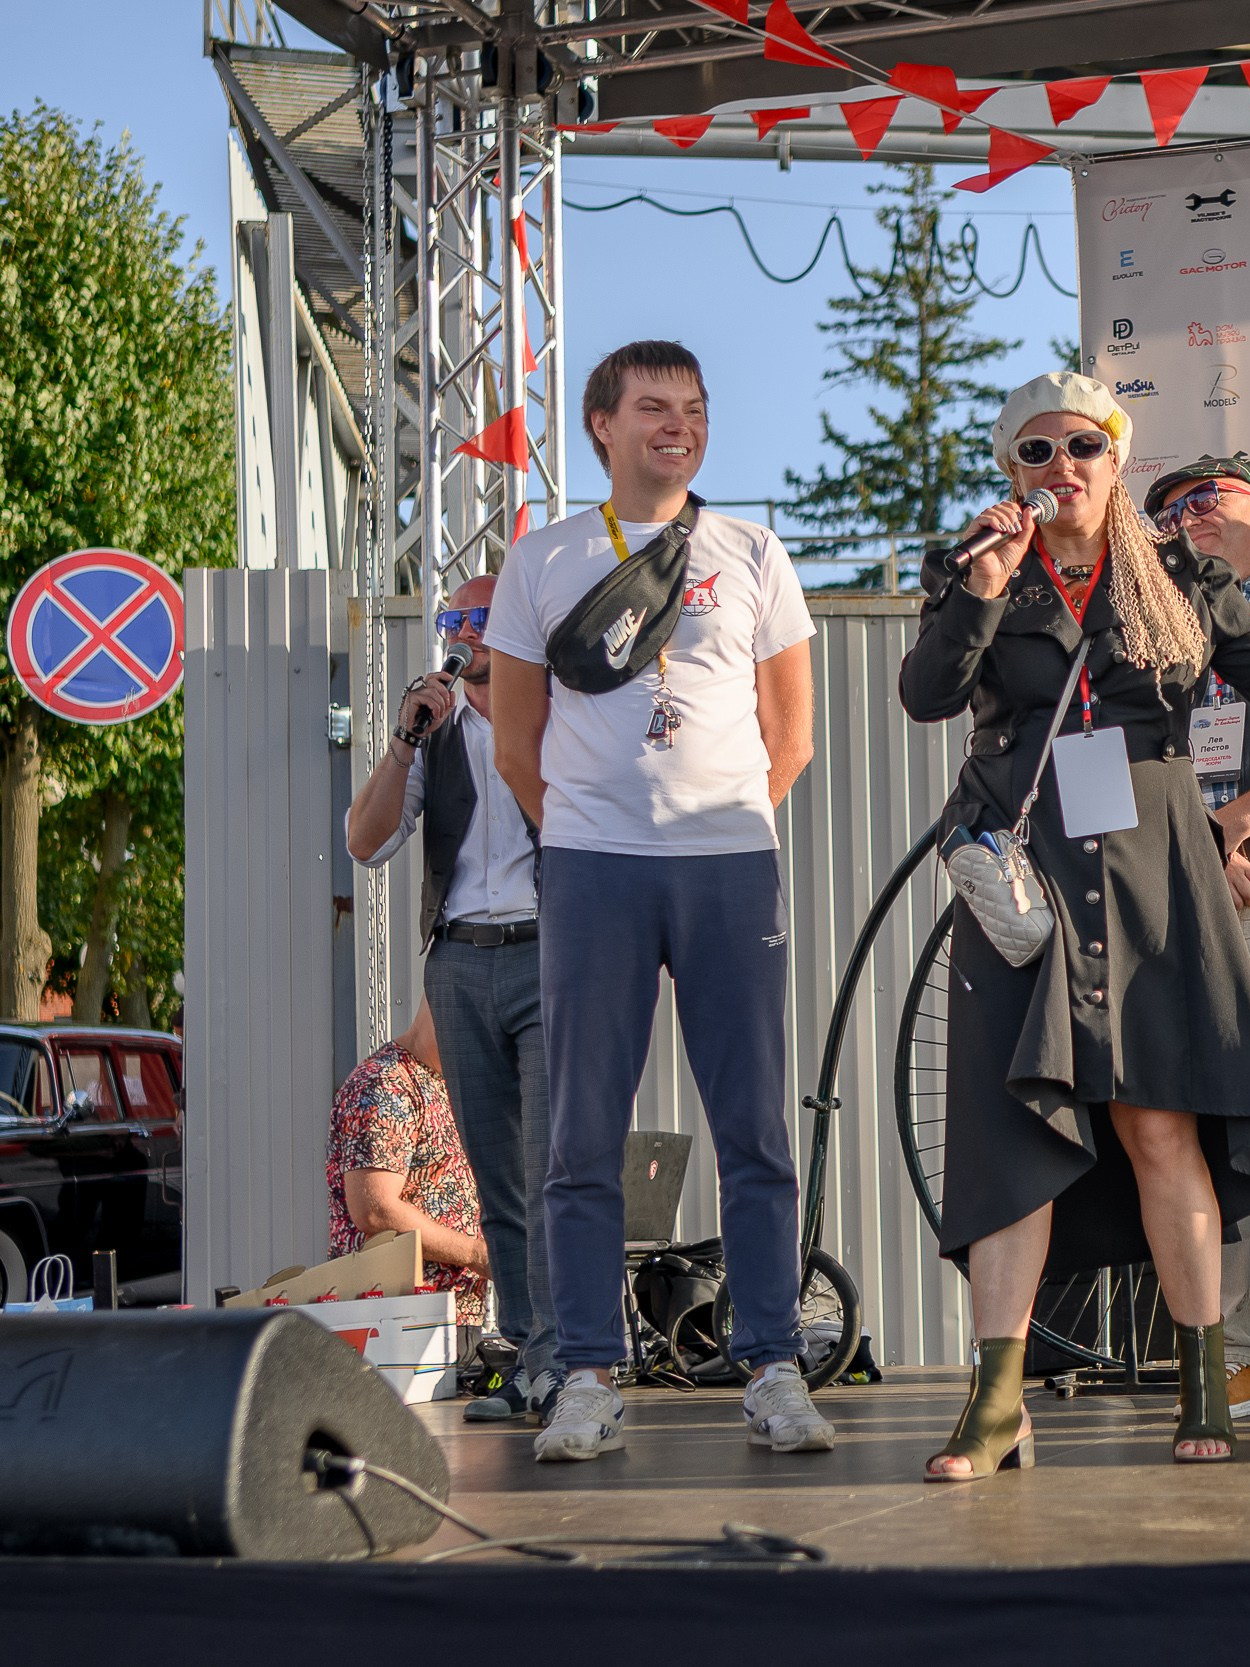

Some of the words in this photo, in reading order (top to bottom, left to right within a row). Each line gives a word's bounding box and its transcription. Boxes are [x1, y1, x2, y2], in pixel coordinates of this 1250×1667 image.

[1180, 267, 1204, 275] GAC
[1205, 261, 1247, 273] MOTOR
[1112, 271, 1144, 280] EVOLUTE
[1204, 397, 1237, 408] MODELS
[603, 608, 638, 655] NIKE
[1200, 744, 1230, 753] Пестов
